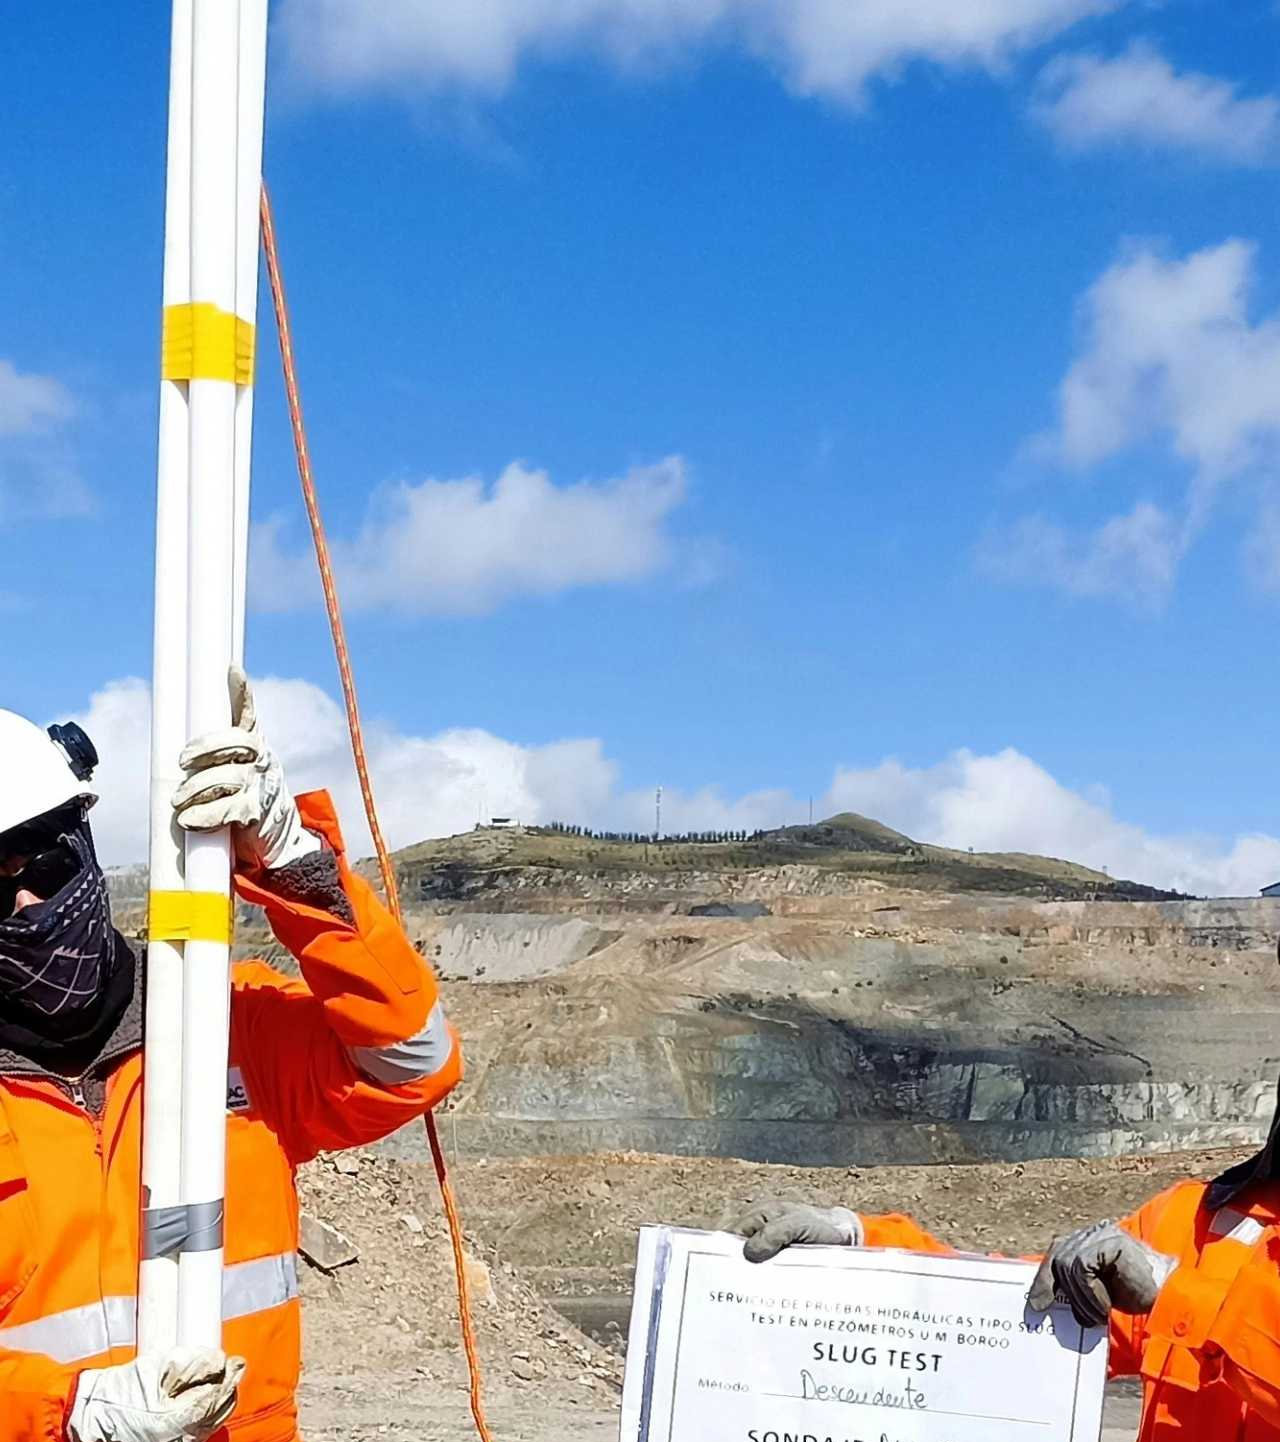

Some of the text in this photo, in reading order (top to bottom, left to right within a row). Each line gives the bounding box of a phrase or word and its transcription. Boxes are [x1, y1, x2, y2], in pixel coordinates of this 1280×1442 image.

[751, 1312, 783, 1325] TEST
[790, 1316, 808, 1328] EN
[781, 1298, 799, 1309] DE
[979, 1317, 1012, 1332] TIPO
[813, 1341, 943, 1373] SLUG TEST
